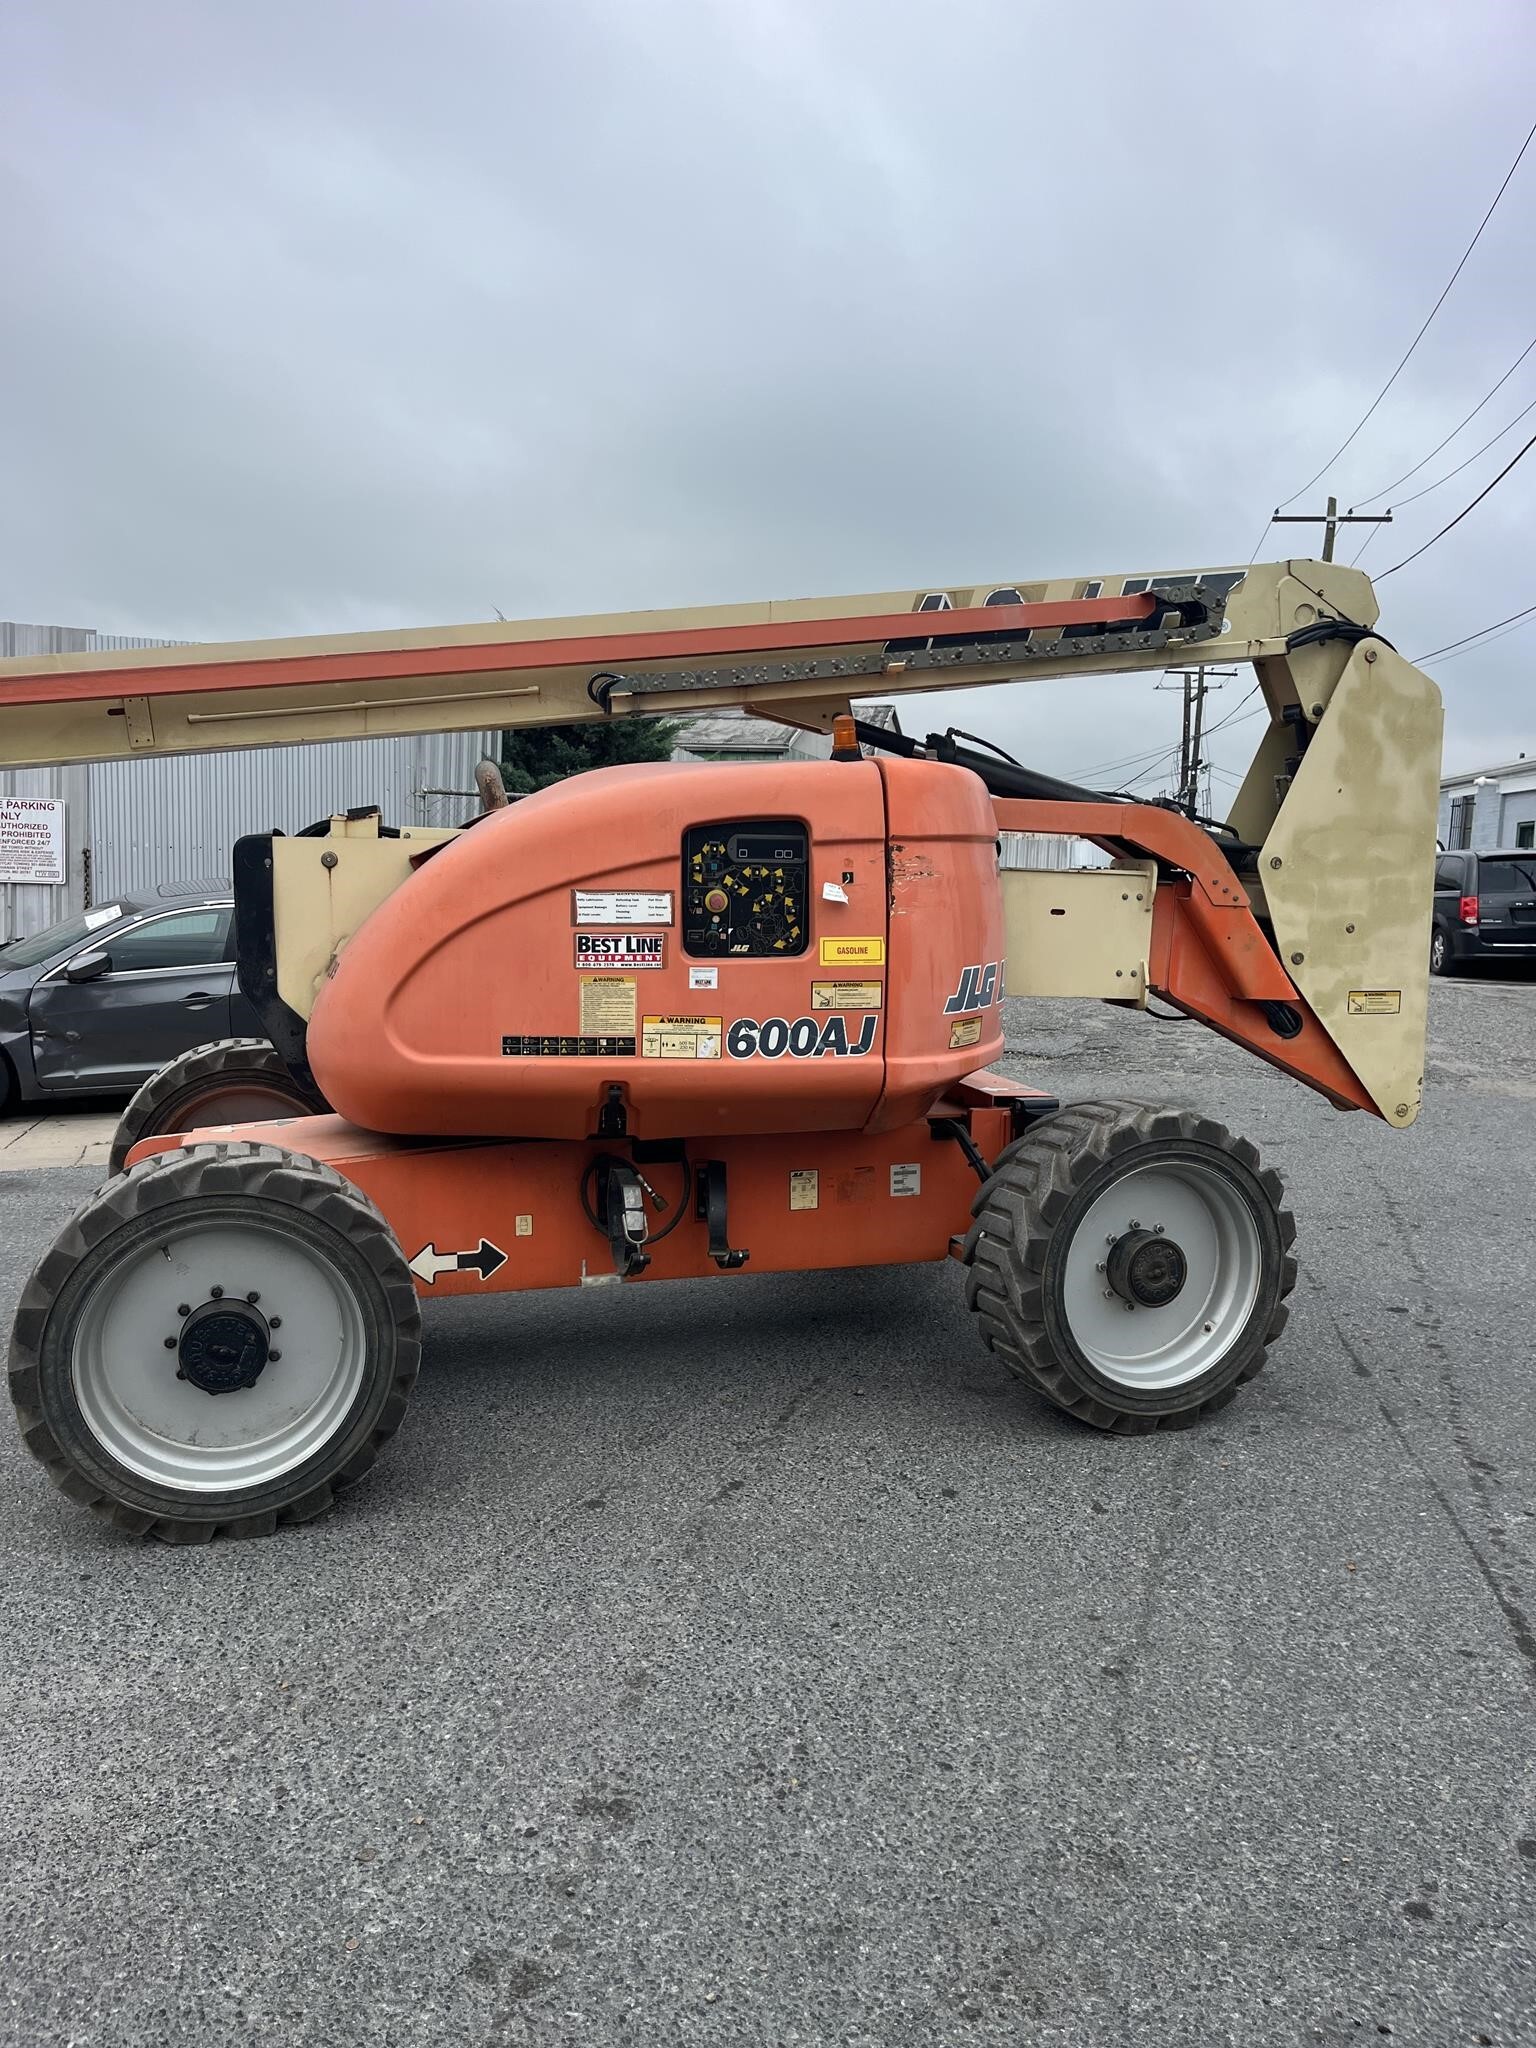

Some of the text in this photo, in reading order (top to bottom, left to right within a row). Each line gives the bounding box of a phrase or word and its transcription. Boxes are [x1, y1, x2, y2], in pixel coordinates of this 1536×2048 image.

[6, 801, 55, 811] PARKING
[1, 811, 21, 820] NLY
[2, 830, 51, 838] PROHIBITED
[578, 936, 662, 953] BEST LINE
[730, 944, 750, 952] JLG
[836, 946, 868, 955] GASOLINE
[943, 962, 998, 1015] JLG
[726, 1015, 879, 1060] 600AJ
